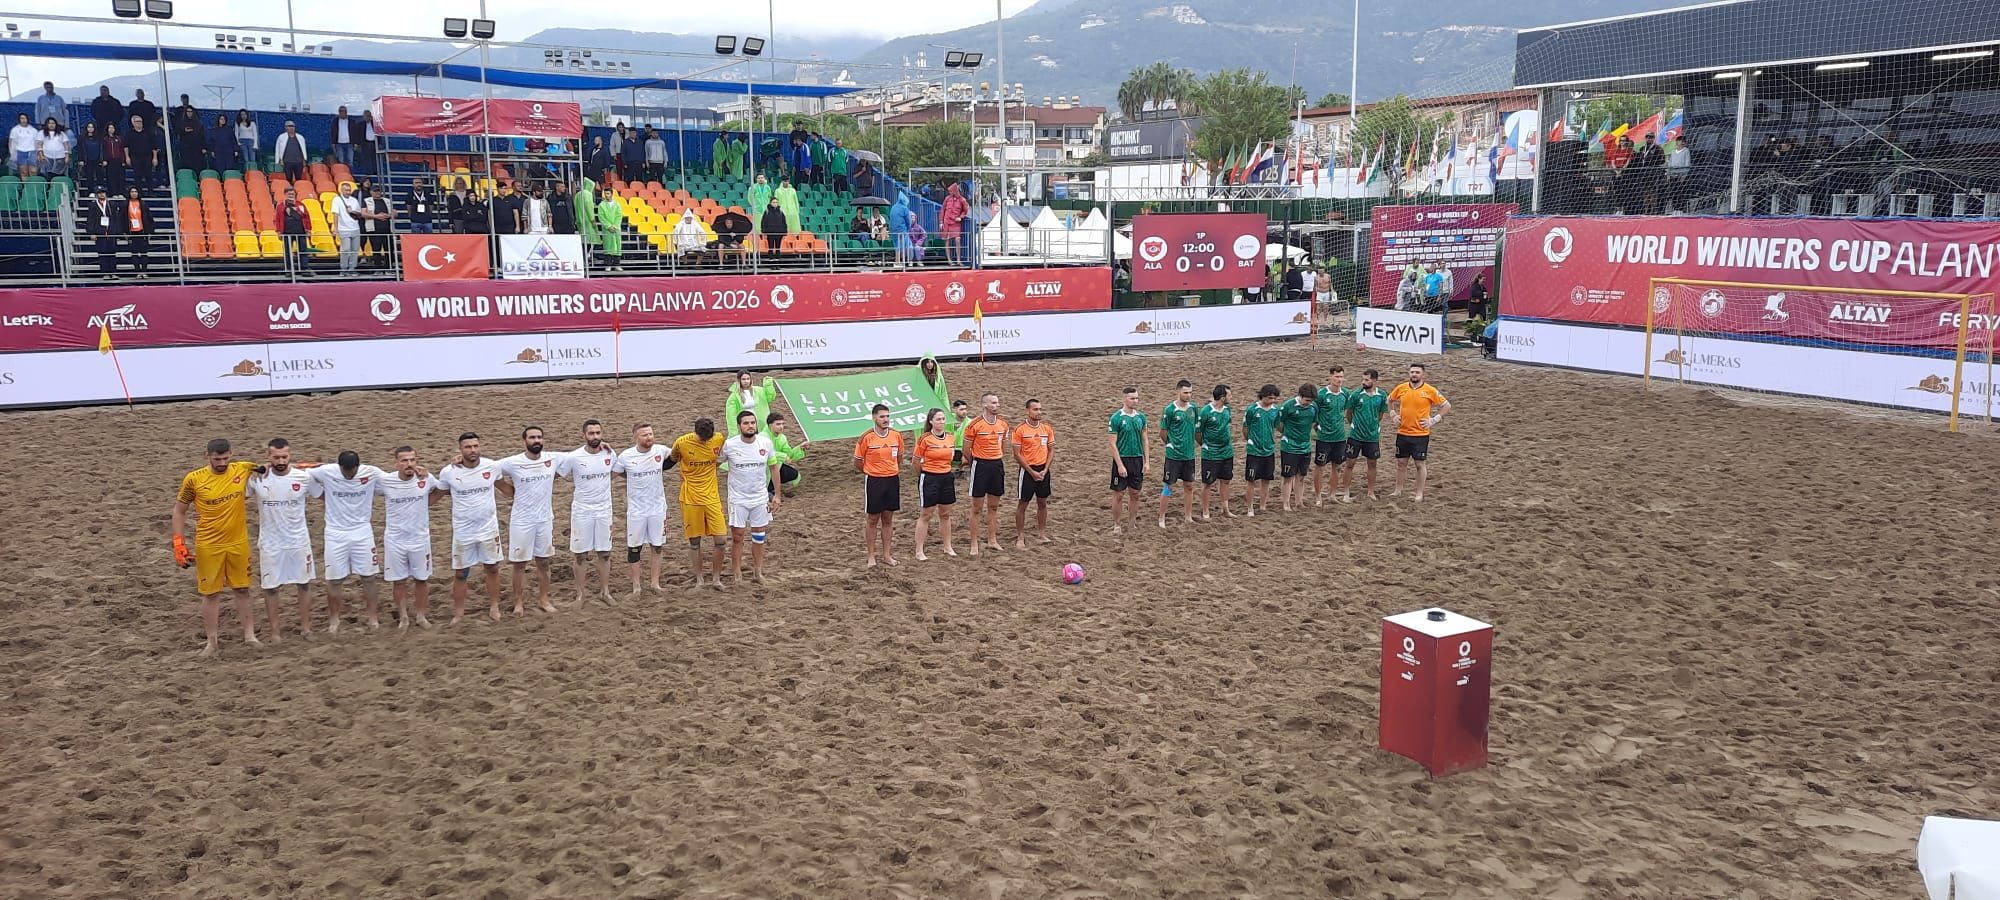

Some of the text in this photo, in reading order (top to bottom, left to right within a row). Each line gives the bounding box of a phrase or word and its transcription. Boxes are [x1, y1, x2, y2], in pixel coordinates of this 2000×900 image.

[1110, 129, 1141, 146] ИНСТИНКТ
[1467, 183, 1483, 192] TRT
[1195, 232, 1206, 240] 1P
[1182, 243, 1215, 253] 12:00
[1607, 235, 1689, 265] WORLD
[1697, 236, 1822, 271] WINNERS
[1829, 239, 1891, 273] CUP
[504, 261, 583, 273] DESIBEL
[1144, 262, 1163, 270] ALA
[1175, 256, 1191, 272] 0
[1210, 255, 1225, 271] 0
[1025, 283, 1062, 295] ALTAV
[416, 290, 760, 318] WORLD WINNERS CUP ALANYA 2026
[1829, 304, 1892, 322] ALTAV
[3, 315, 53, 326] LetFix
[87, 313, 148, 328] AVENA
[1362, 320, 1435, 345] FERYAPI
[800, 382, 913, 404] LIVING
[1317, 453, 1326, 462] 23
[1206, 471, 1211, 479] 7
